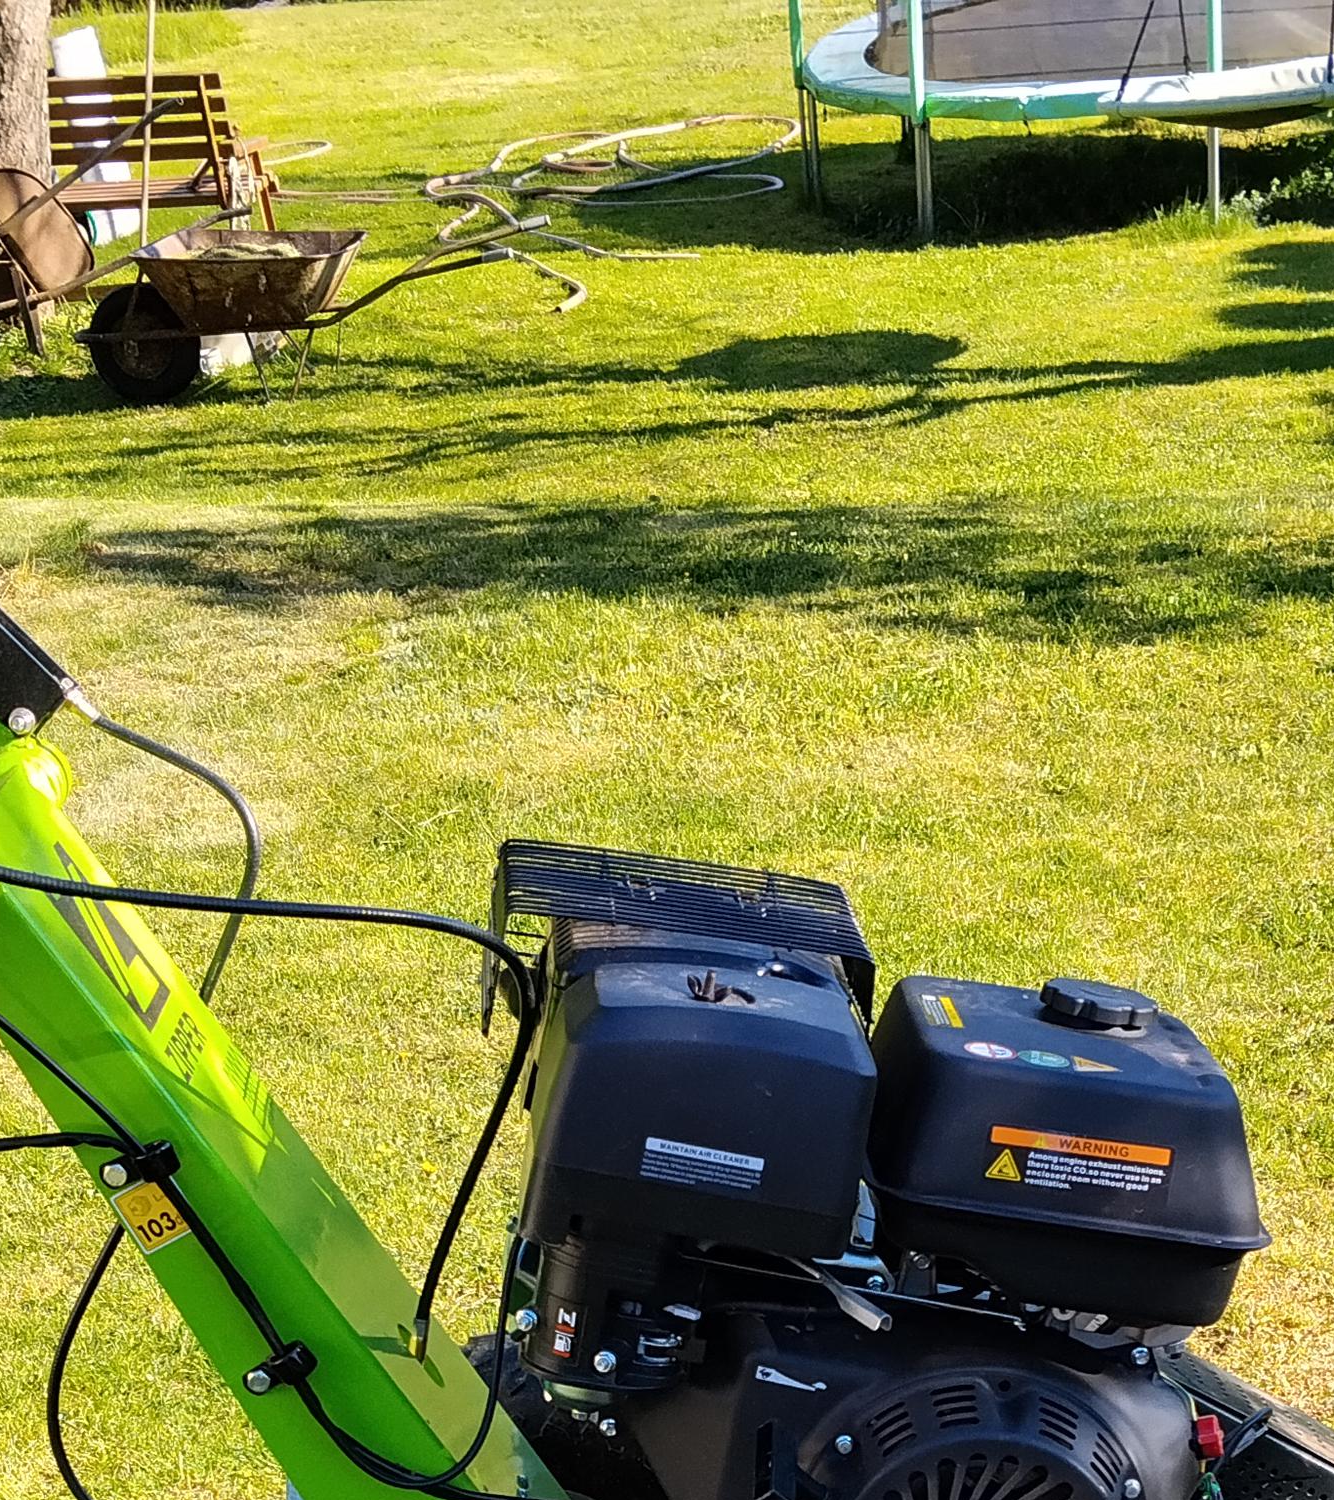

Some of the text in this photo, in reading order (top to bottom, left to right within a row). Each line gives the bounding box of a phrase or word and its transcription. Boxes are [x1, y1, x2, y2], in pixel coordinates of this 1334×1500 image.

[165, 1012, 207, 1084] ZIPPER
[660, 1142, 750, 1166] MAINTAIN AIR CLEANER
[1059, 1138, 1130, 1158] WARNING
[1027, 1160, 1049, 1169] there
[1050, 1164, 1071, 1173] toxic
[1100, 1170, 1124, 1179] never
[1141, 1175, 1150, 1183] in
[1028, 1151, 1058, 1163] Among
[1059, 1157, 1087, 1166] engine
[1088, 1160, 1121, 1170] exhaust
[1026, 1169, 1149, 1191] enclosed room without good
